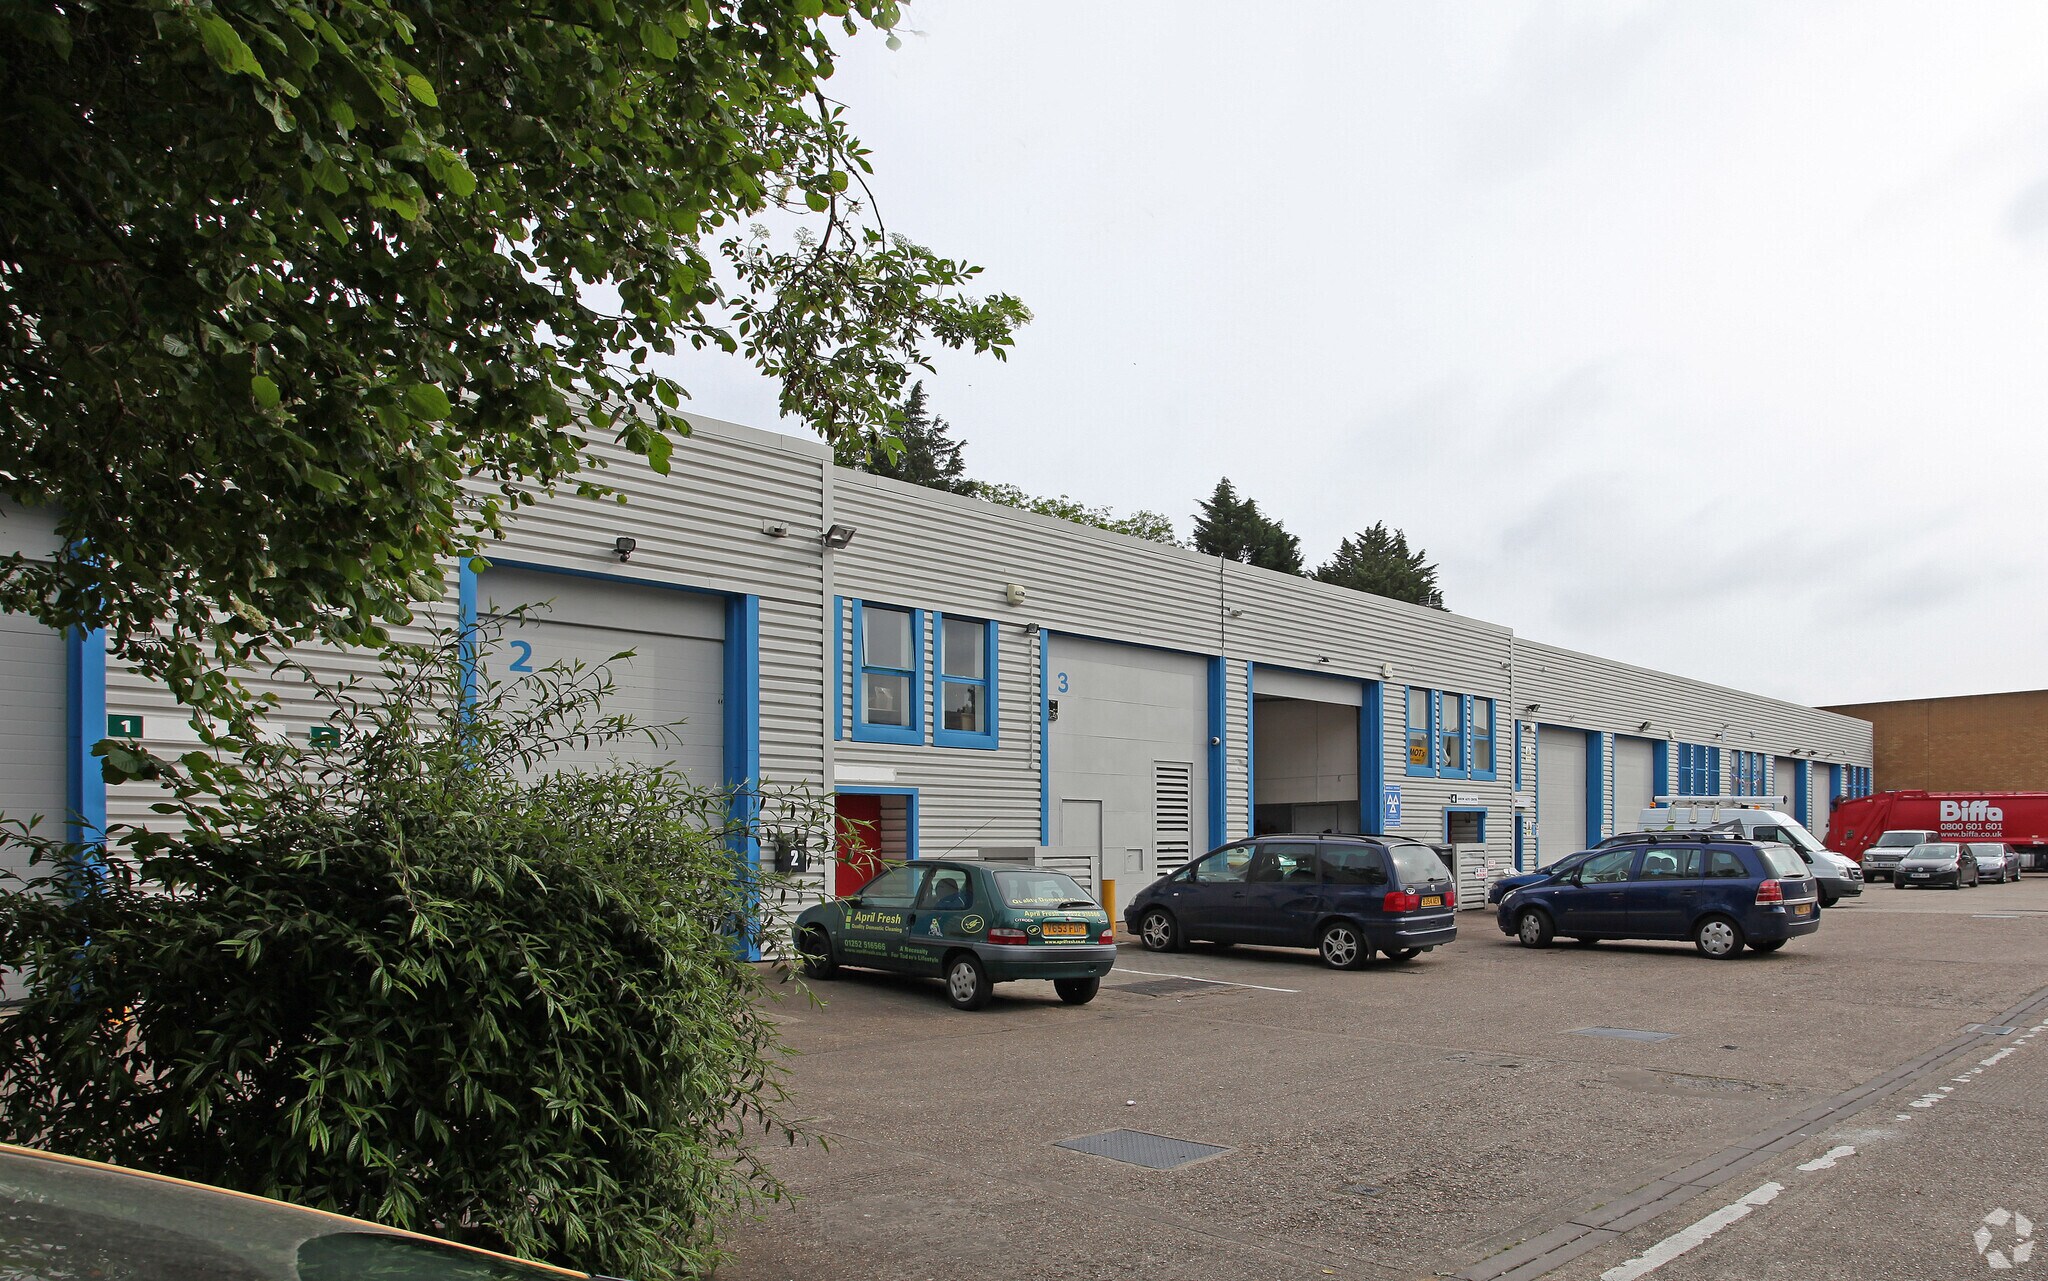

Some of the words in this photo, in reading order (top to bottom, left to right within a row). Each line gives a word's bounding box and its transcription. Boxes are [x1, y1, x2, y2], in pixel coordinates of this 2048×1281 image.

[510, 640, 533, 673] 2
[1057, 672, 1069, 693] 3
[120, 720, 131, 733] 1
[1940, 800, 2003, 821] Biffa
[790, 849, 799, 866] 2
[855, 911, 876, 924] April
[877, 912, 901, 924] Fresh
[844, 939, 862, 948] 01252
